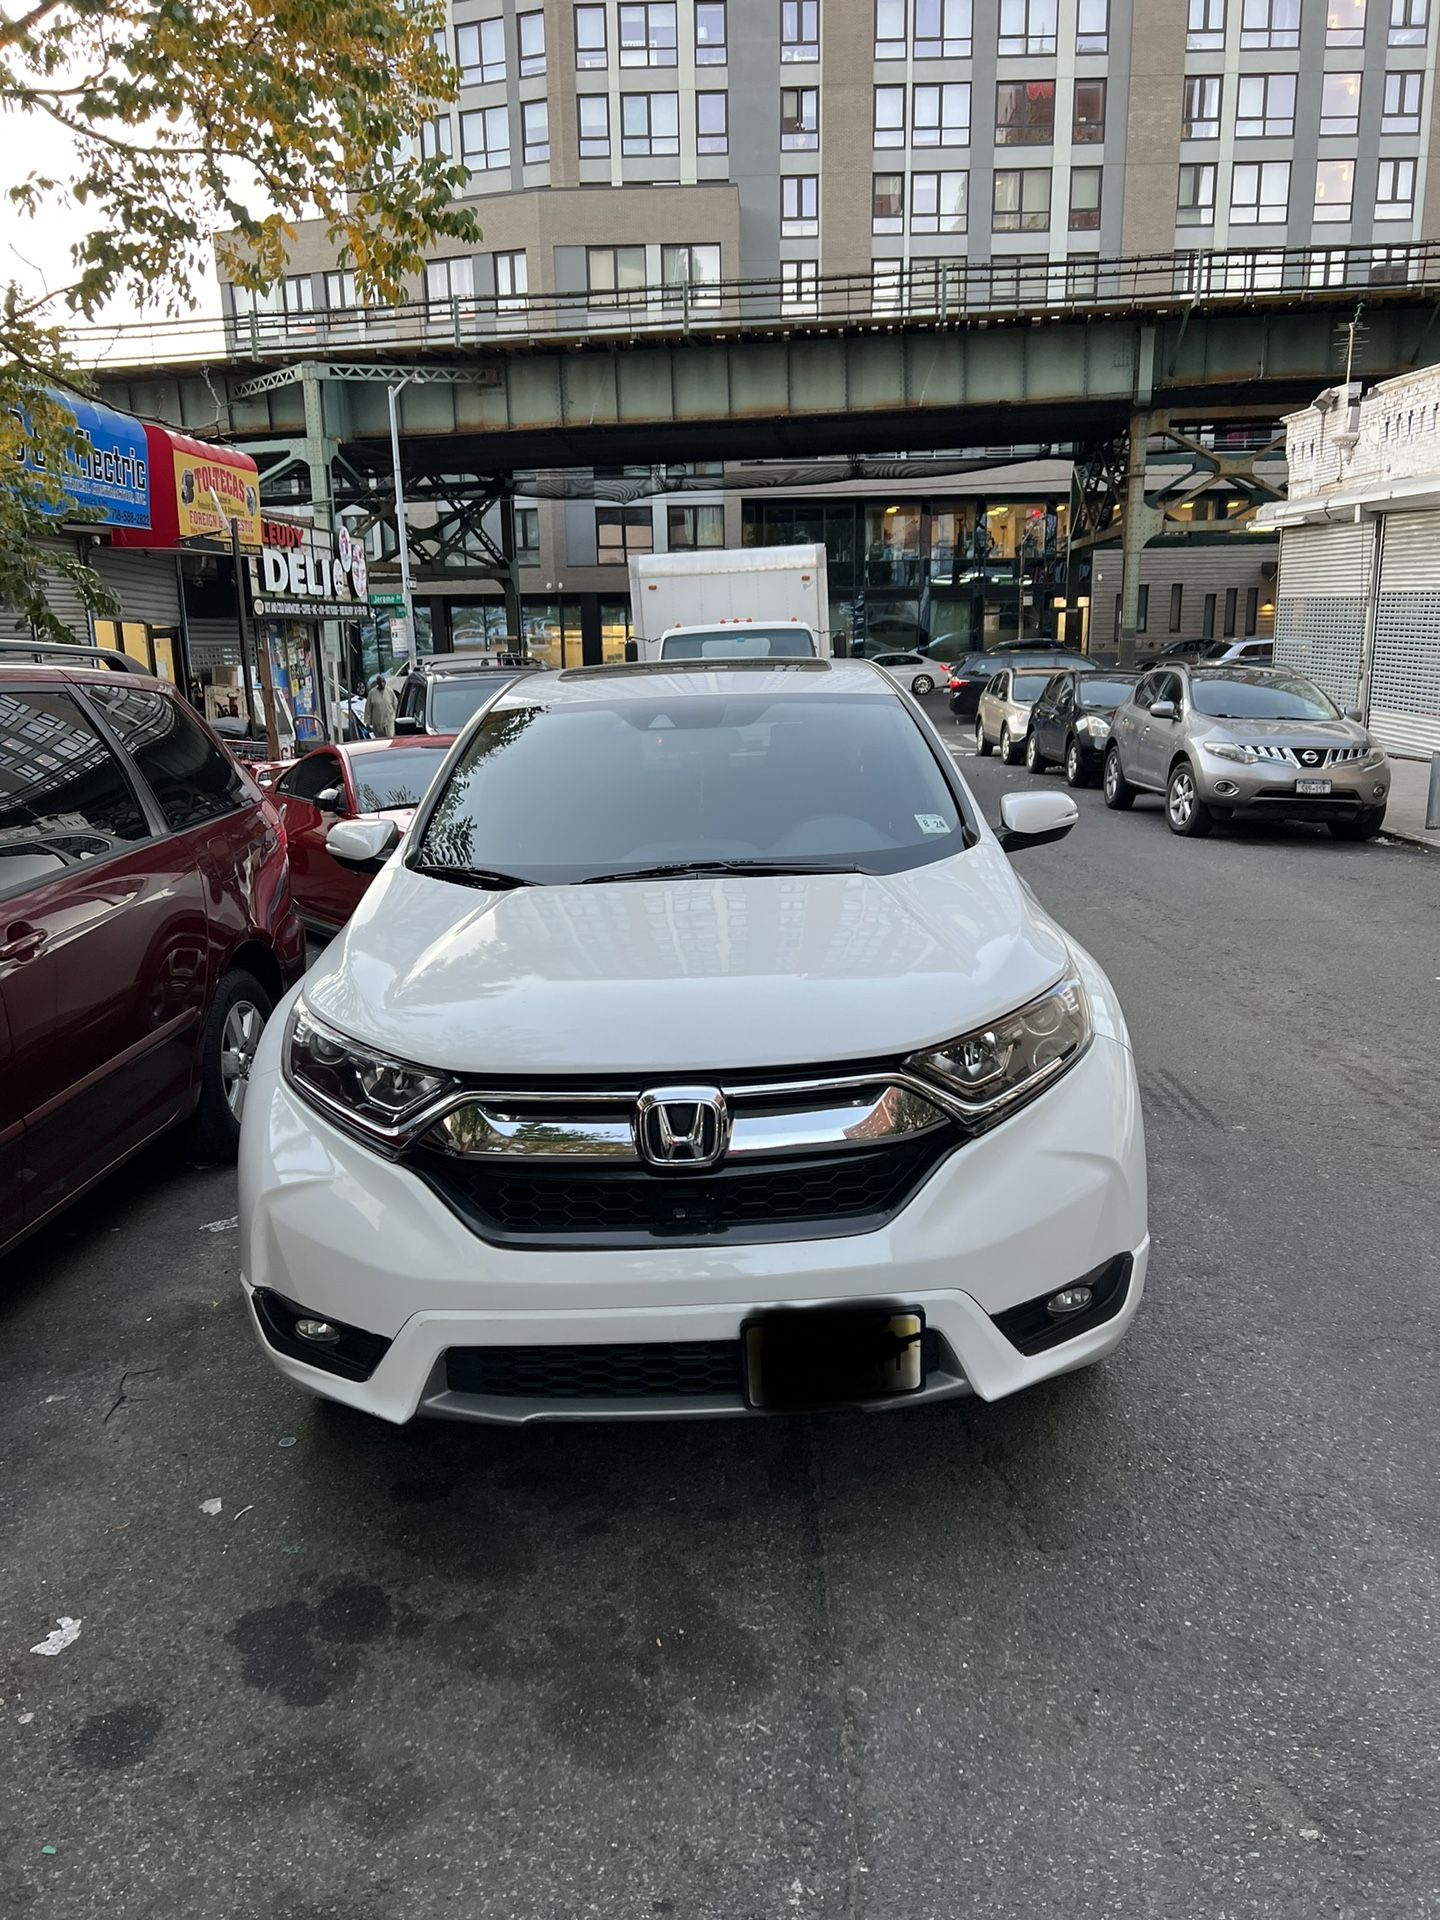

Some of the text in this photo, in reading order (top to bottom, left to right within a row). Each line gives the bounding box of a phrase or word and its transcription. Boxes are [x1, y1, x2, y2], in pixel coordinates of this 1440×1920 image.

[194, 466, 245, 503] TOLTECAS
[189, 510, 217, 527] FOREIGN
[261, 520, 304, 548] LEUDY
[263, 548, 331, 596] DELI
